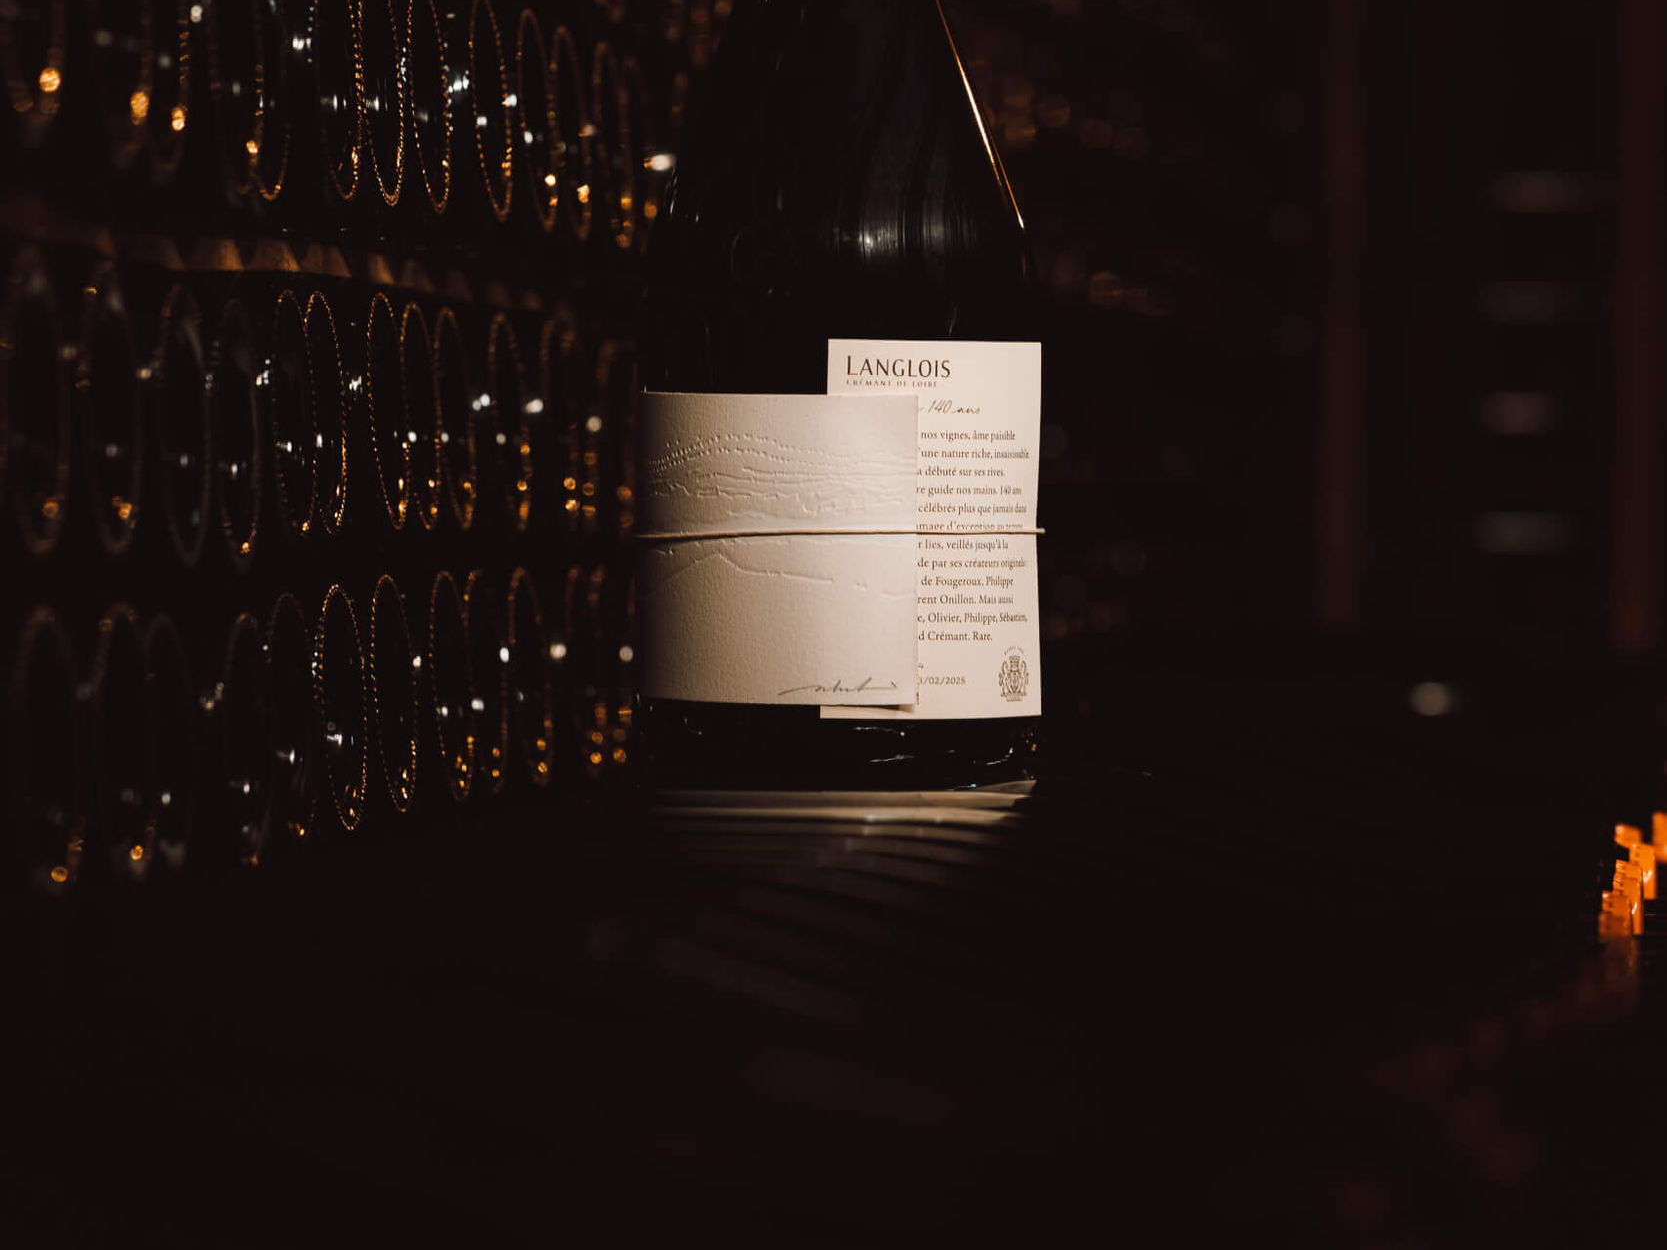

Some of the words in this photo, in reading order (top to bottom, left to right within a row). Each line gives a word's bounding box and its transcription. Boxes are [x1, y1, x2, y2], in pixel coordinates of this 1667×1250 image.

[847, 355, 951, 378] LANGLOIS
[928, 399, 953, 414] 140
[921, 431, 938, 439] nos
[941, 430, 971, 442] vignes,
[942, 449, 970, 458] nature
[972, 448, 993, 459] riche,
[925, 466, 957, 476] débuté
[928, 484, 954, 497] guide
[1000, 485, 1012, 495] 140
[958, 504, 976, 515] plus
[977, 506, 991, 516] que
[992, 505, 1014, 516] jamais
[926, 539, 944, 549] lies,
[946, 539, 973, 549] veillés
[918, 558, 929, 567] de
[932, 560, 947, 570] par
[965, 558, 999, 567] créateurs
[922, 576, 933, 585] de
[986, 576, 1014, 588] Philippe
[940, 594, 976, 604] Onillon.
[979, 594, 996, 604] Mais
[998, 595, 1014, 604] aussi
[928, 613, 962, 623] Olivier,
[964, 613, 998, 625] Philippe,
[973, 631, 993, 641] Rare.
